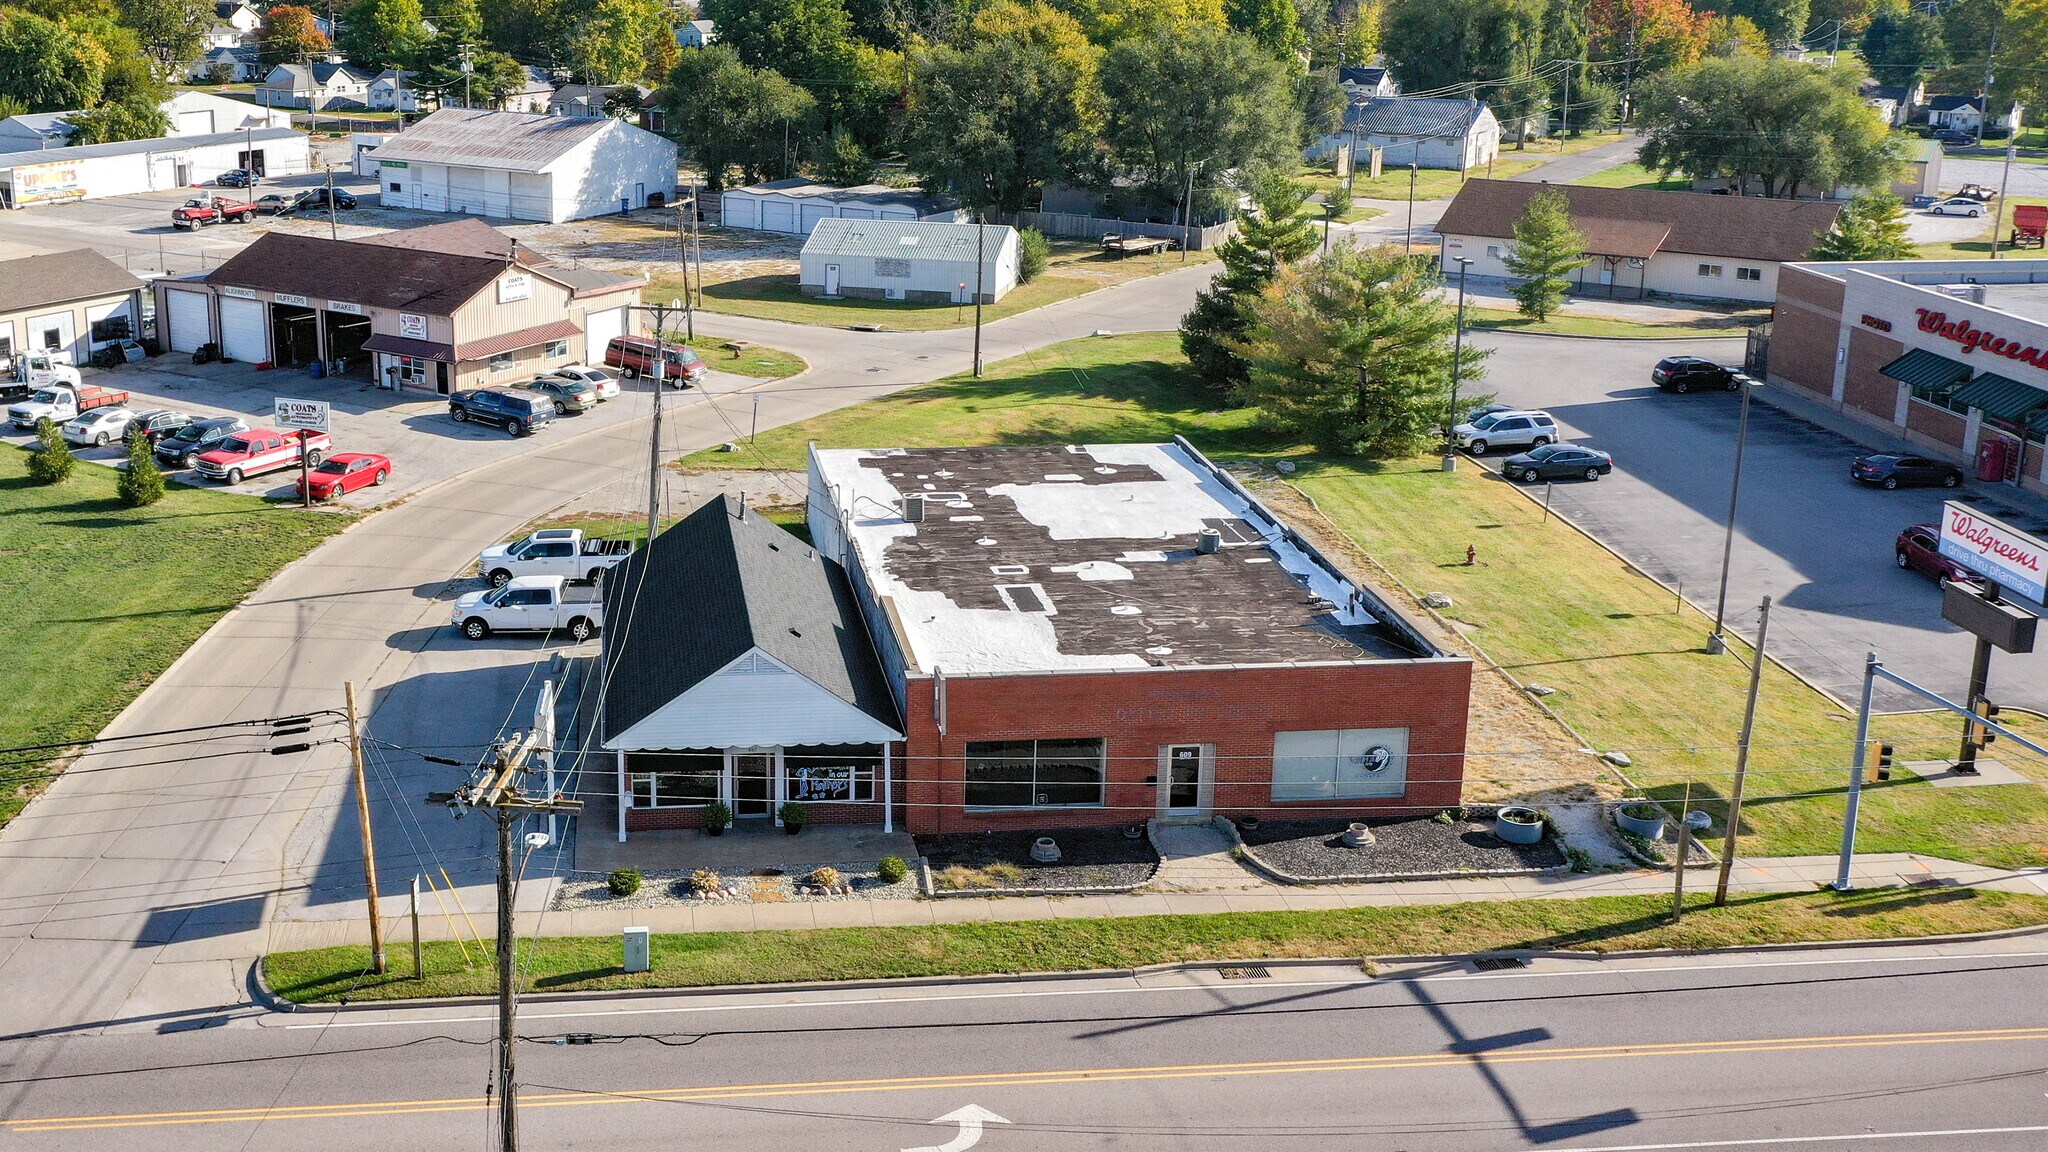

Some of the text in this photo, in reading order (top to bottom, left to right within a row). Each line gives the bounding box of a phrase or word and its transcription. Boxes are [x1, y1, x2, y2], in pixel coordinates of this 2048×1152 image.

[23, 169, 77, 187] UPKE'S
[225, 286, 256, 298] ALIGNMENTS
[276, 294, 305, 305] MUFFLERS
[333, 302, 357, 312] BRAKES
[1861, 313, 1892, 333] PHOTO
[291, 403, 317, 413] COATS
[1951, 511, 2040, 572] Walgreens
[1948, 544, 2034, 597] drive thru pharmacy
[1179, 751, 1192, 760] 609
